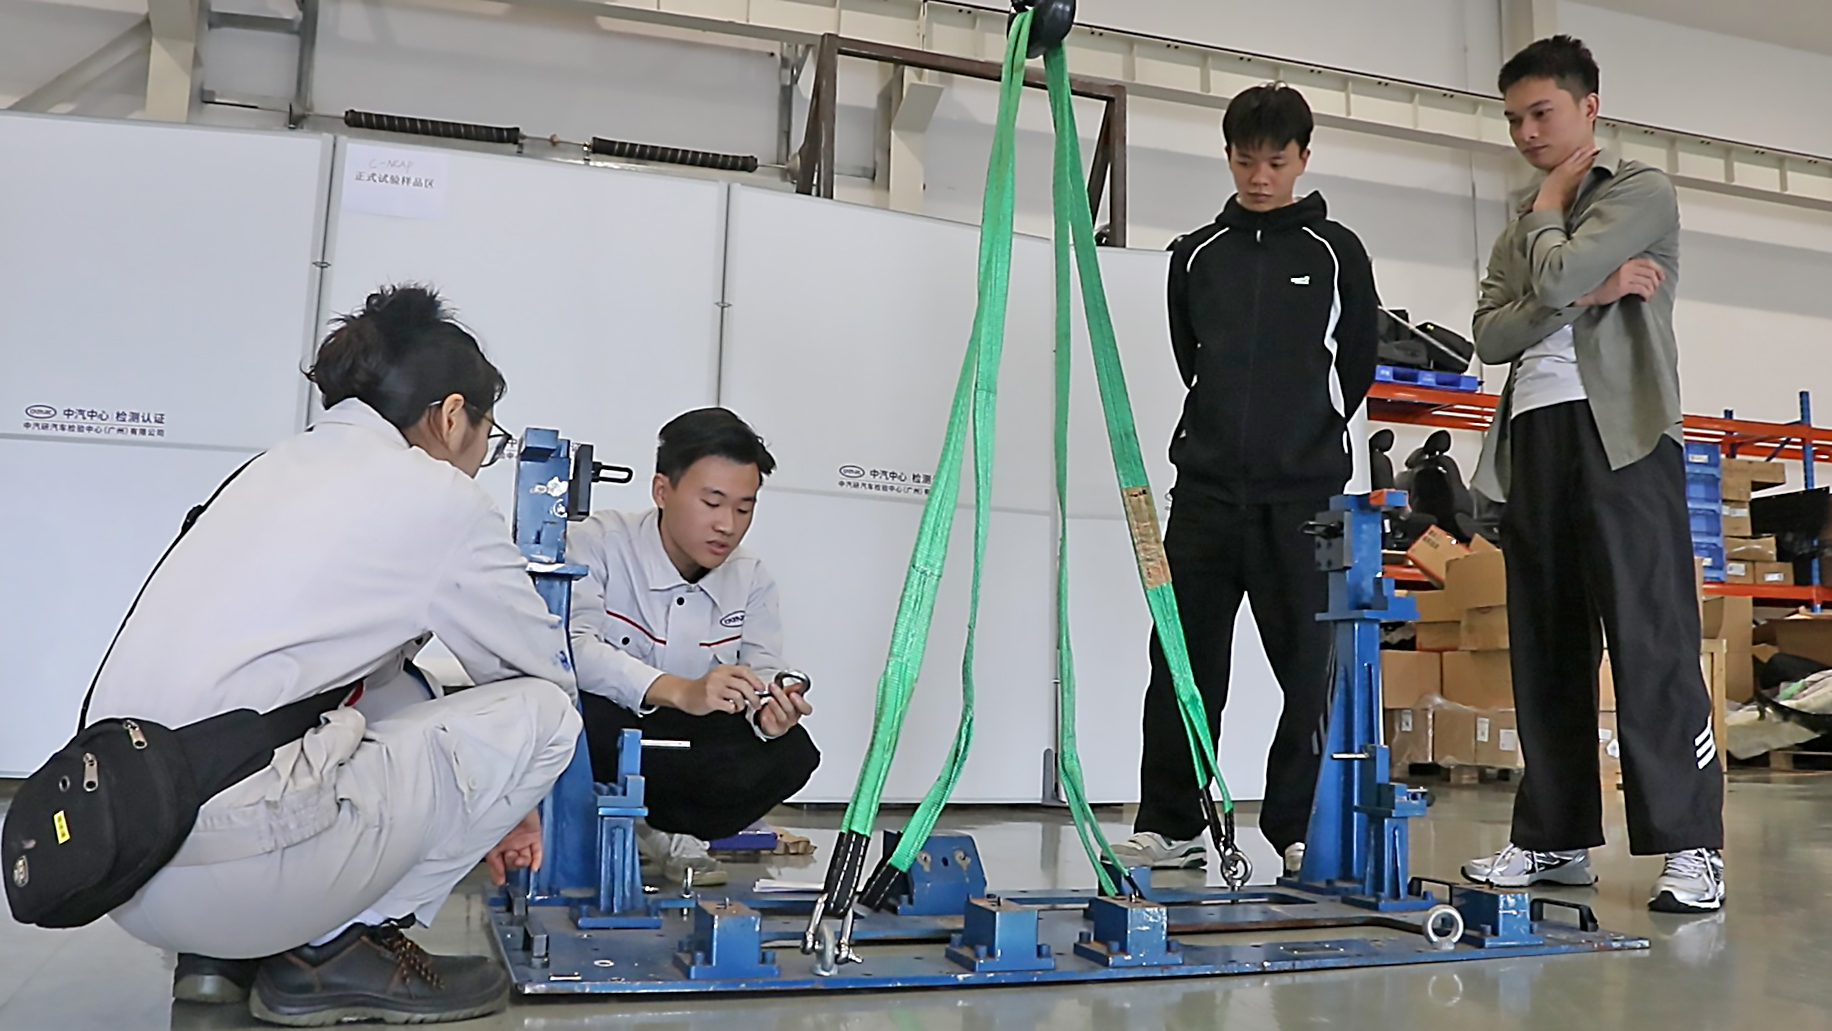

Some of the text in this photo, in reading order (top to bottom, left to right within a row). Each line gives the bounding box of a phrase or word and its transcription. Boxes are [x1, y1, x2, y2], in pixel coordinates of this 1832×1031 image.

[355, 171, 434, 189] 正式试验样品区
[63, 408, 109, 421] 中汽中心
[115, 411, 165, 424] 检测认证
[870, 469, 907, 482] 中汽中心
[912, 473, 936, 484] 检测
